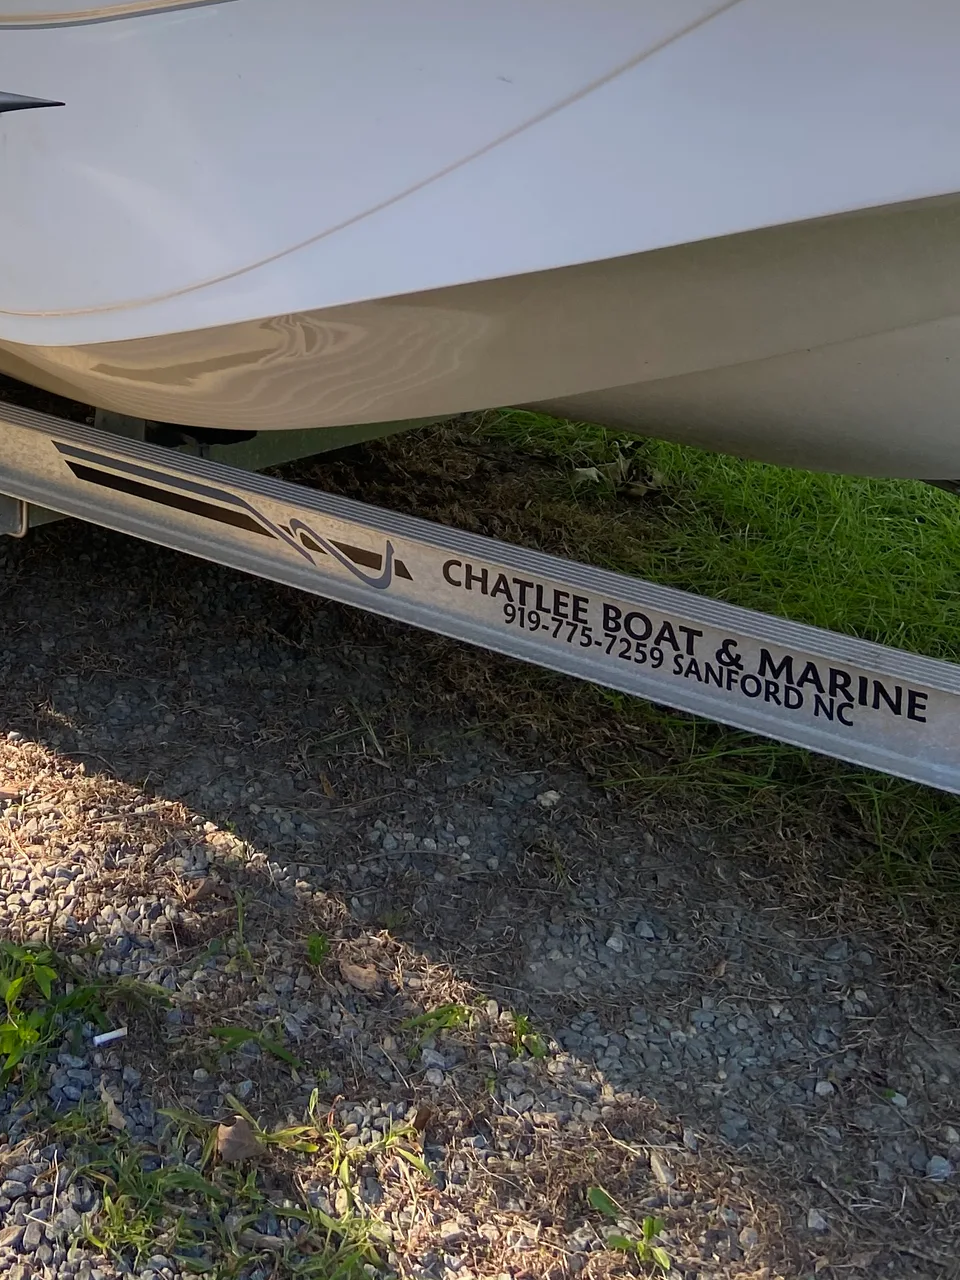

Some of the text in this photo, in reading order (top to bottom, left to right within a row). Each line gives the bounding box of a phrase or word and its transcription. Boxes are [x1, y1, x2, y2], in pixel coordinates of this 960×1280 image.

[442, 559, 928, 723] CHATLEE BOAT & MARINE
[503, 603, 854, 726] 919-775-7259 SANFORD NC
